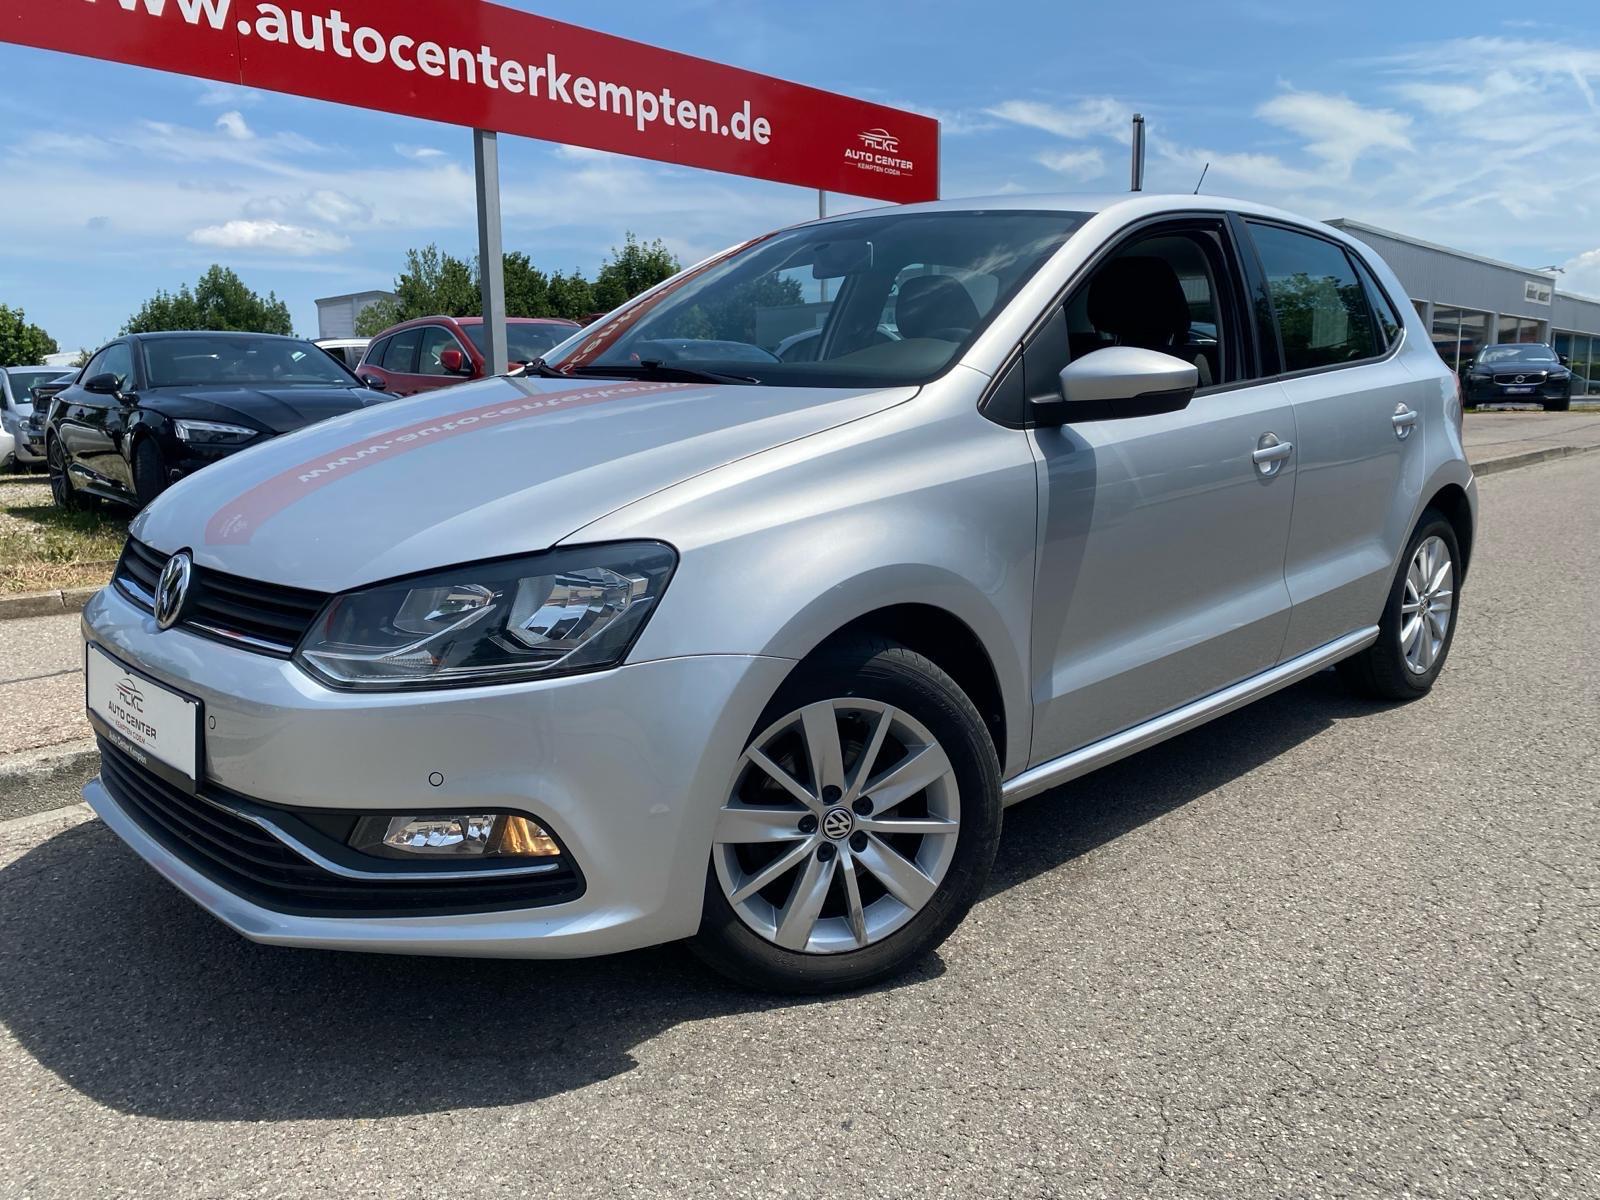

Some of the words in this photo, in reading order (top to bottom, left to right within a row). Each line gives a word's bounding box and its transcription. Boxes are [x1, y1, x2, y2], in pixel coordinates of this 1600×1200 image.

[84, 0, 772, 145] w.autocenterkempten.de
[844, 148, 873, 162] AUTO
[875, 154, 913, 170] CENTER
[857, 162, 884, 173] KEMPTEN
[108, 701, 125, 720] AUTO
[126, 713, 157, 740] CENTER
